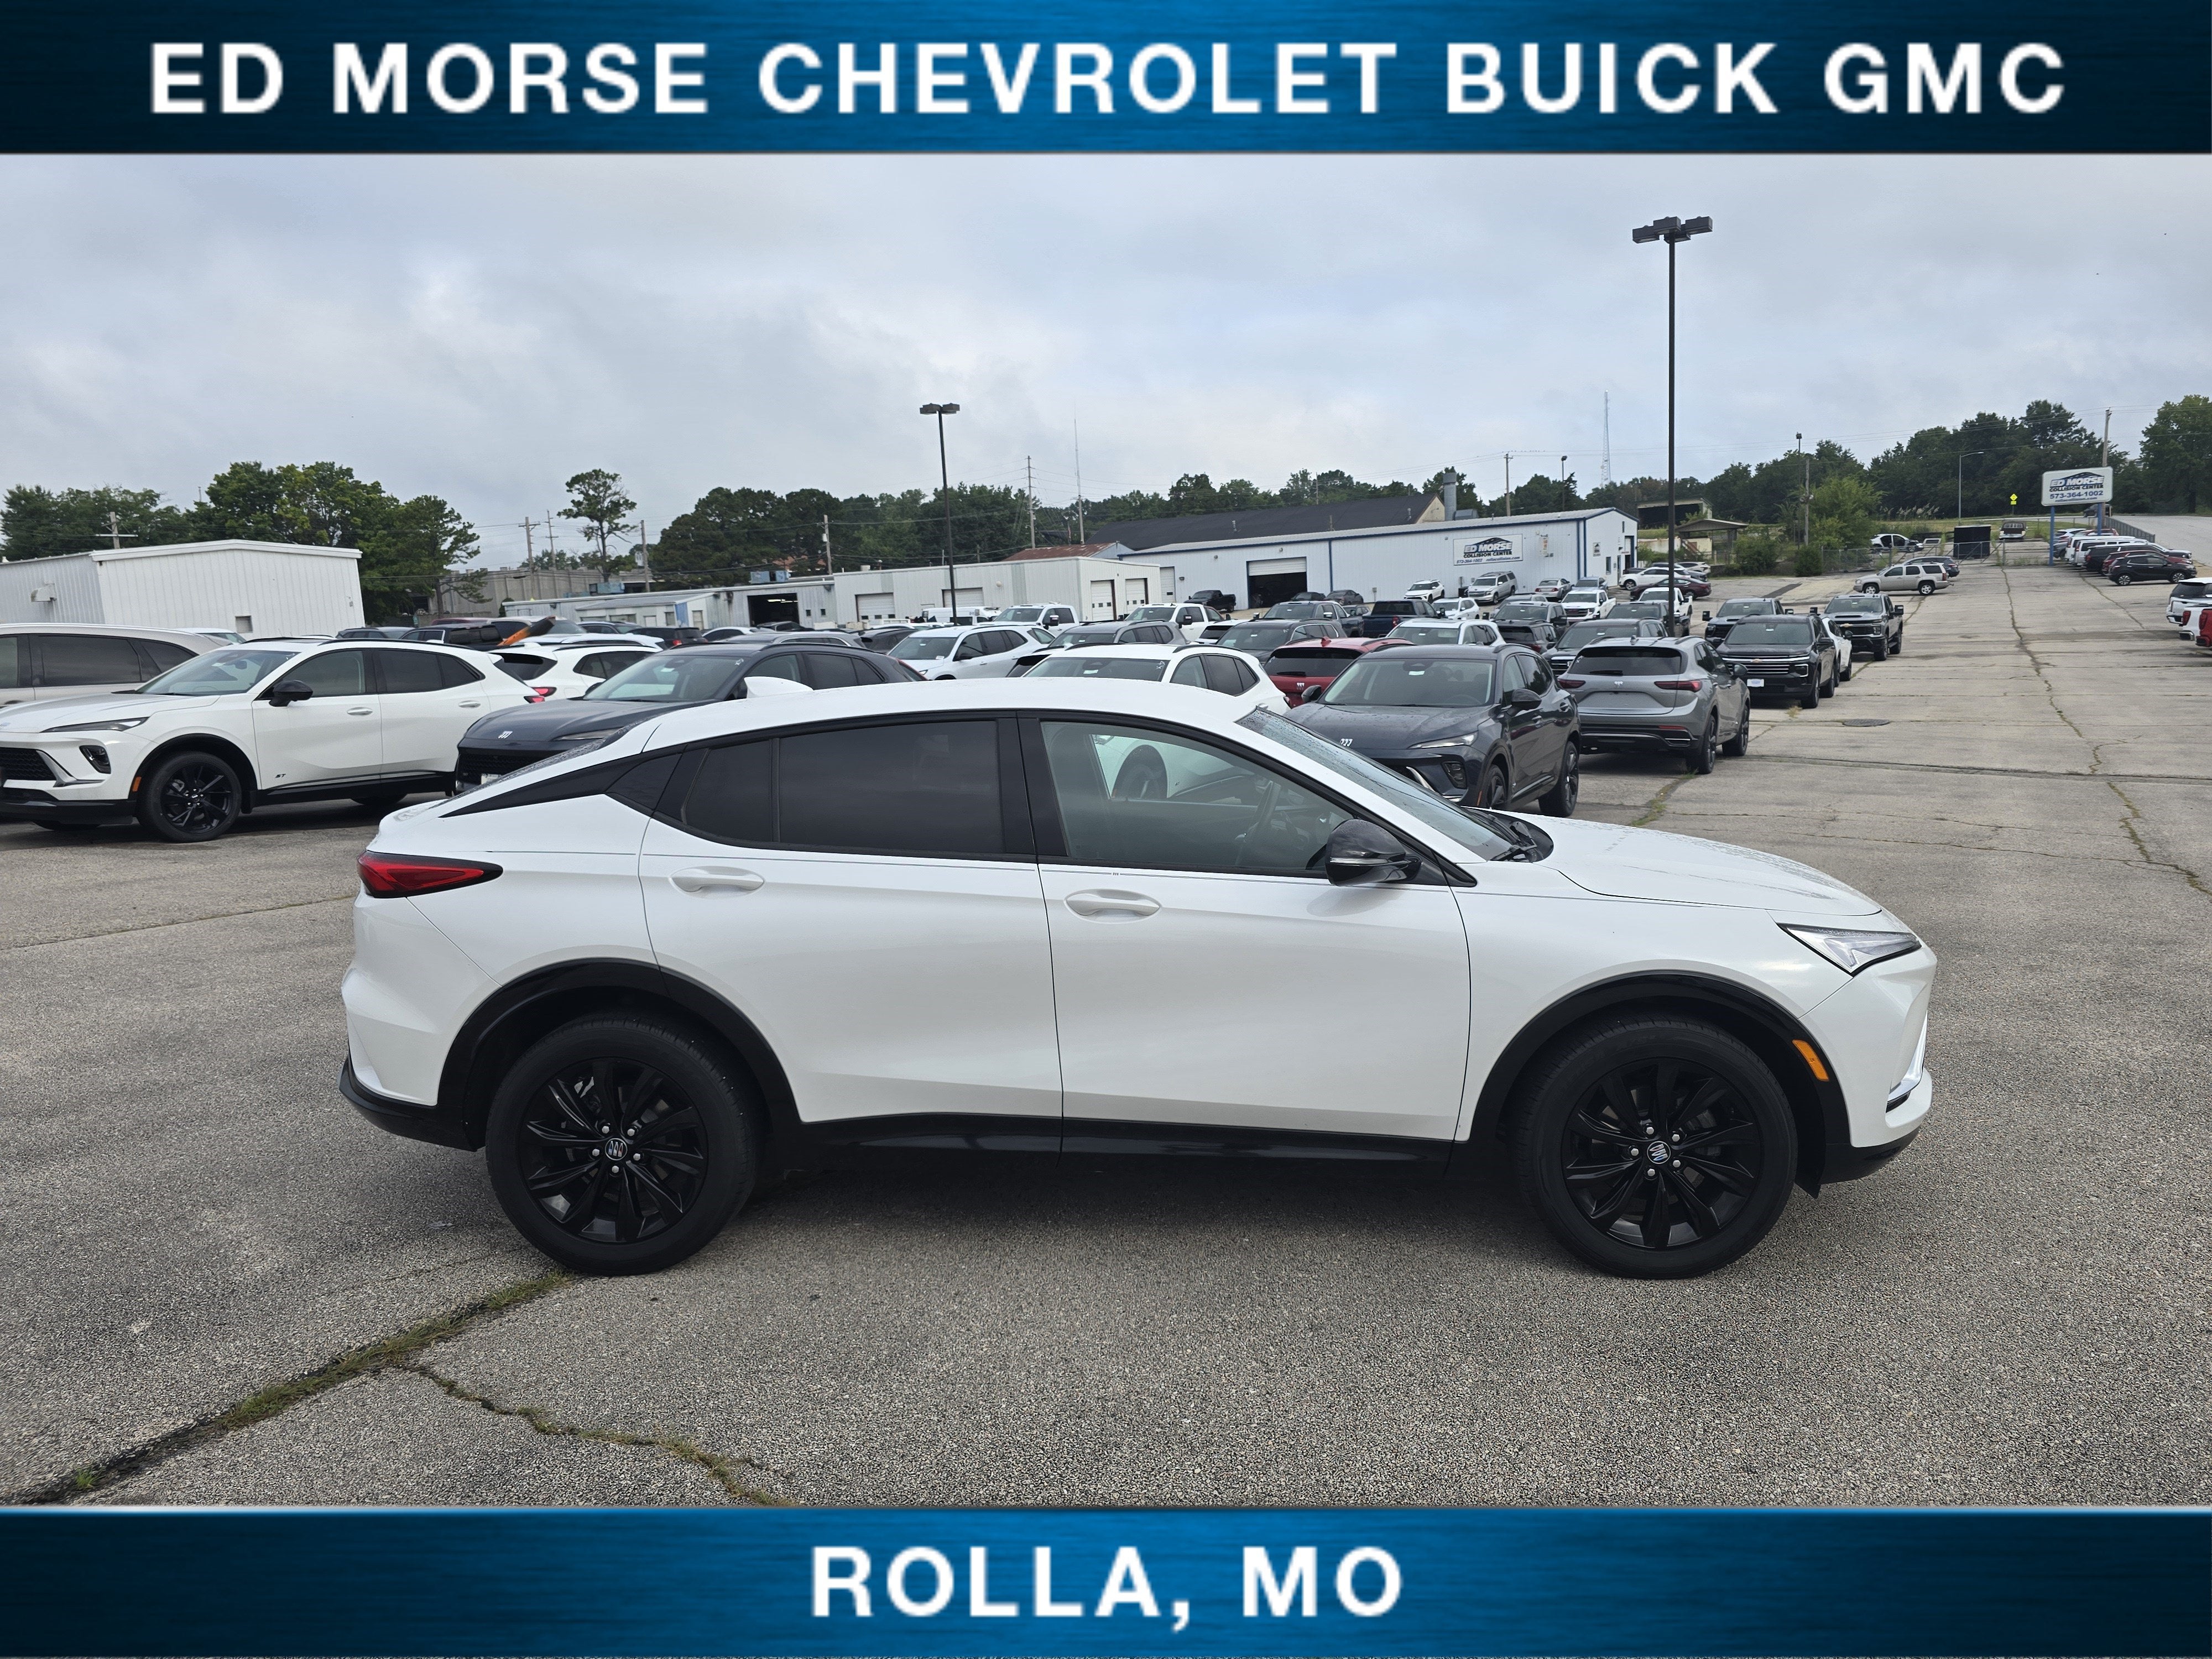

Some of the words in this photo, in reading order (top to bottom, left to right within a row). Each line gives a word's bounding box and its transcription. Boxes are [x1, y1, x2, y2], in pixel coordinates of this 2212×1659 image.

[2066, 476, 2104, 485] MORSE
[2050, 491, 2104, 499] 573-364-1002
[1478, 542, 1512, 551] MORSE
